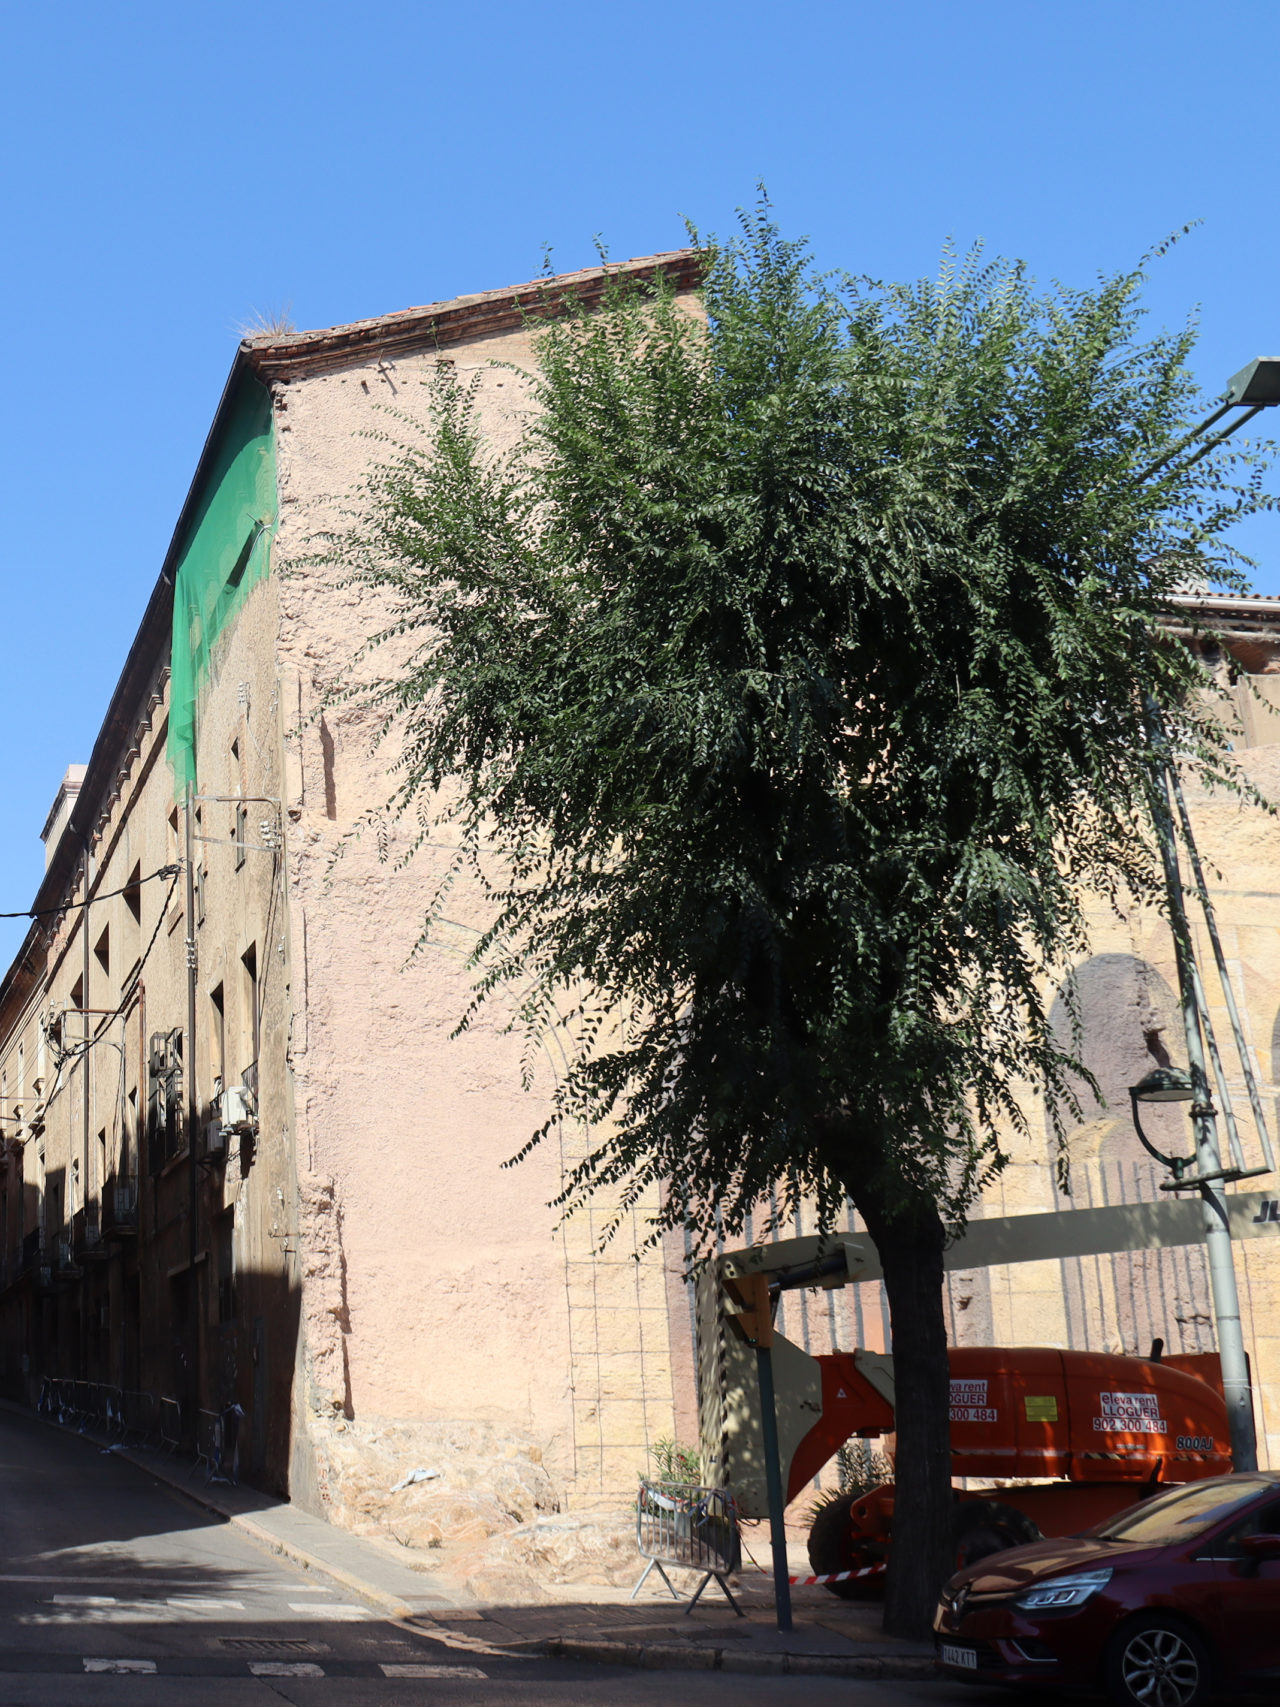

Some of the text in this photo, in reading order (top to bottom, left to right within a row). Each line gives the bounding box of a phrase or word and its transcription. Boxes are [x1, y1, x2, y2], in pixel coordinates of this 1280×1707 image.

[963, 1382, 986, 1393] rent
[1135, 1397, 1157, 1407] rent
[950, 1408, 995, 1421] 300 484
[1102, 1406, 1158, 1418] LLOGUER
[1093, 1418, 1166, 1433] 902 300 484
[1177, 1437, 1213, 1450] 800AJ
